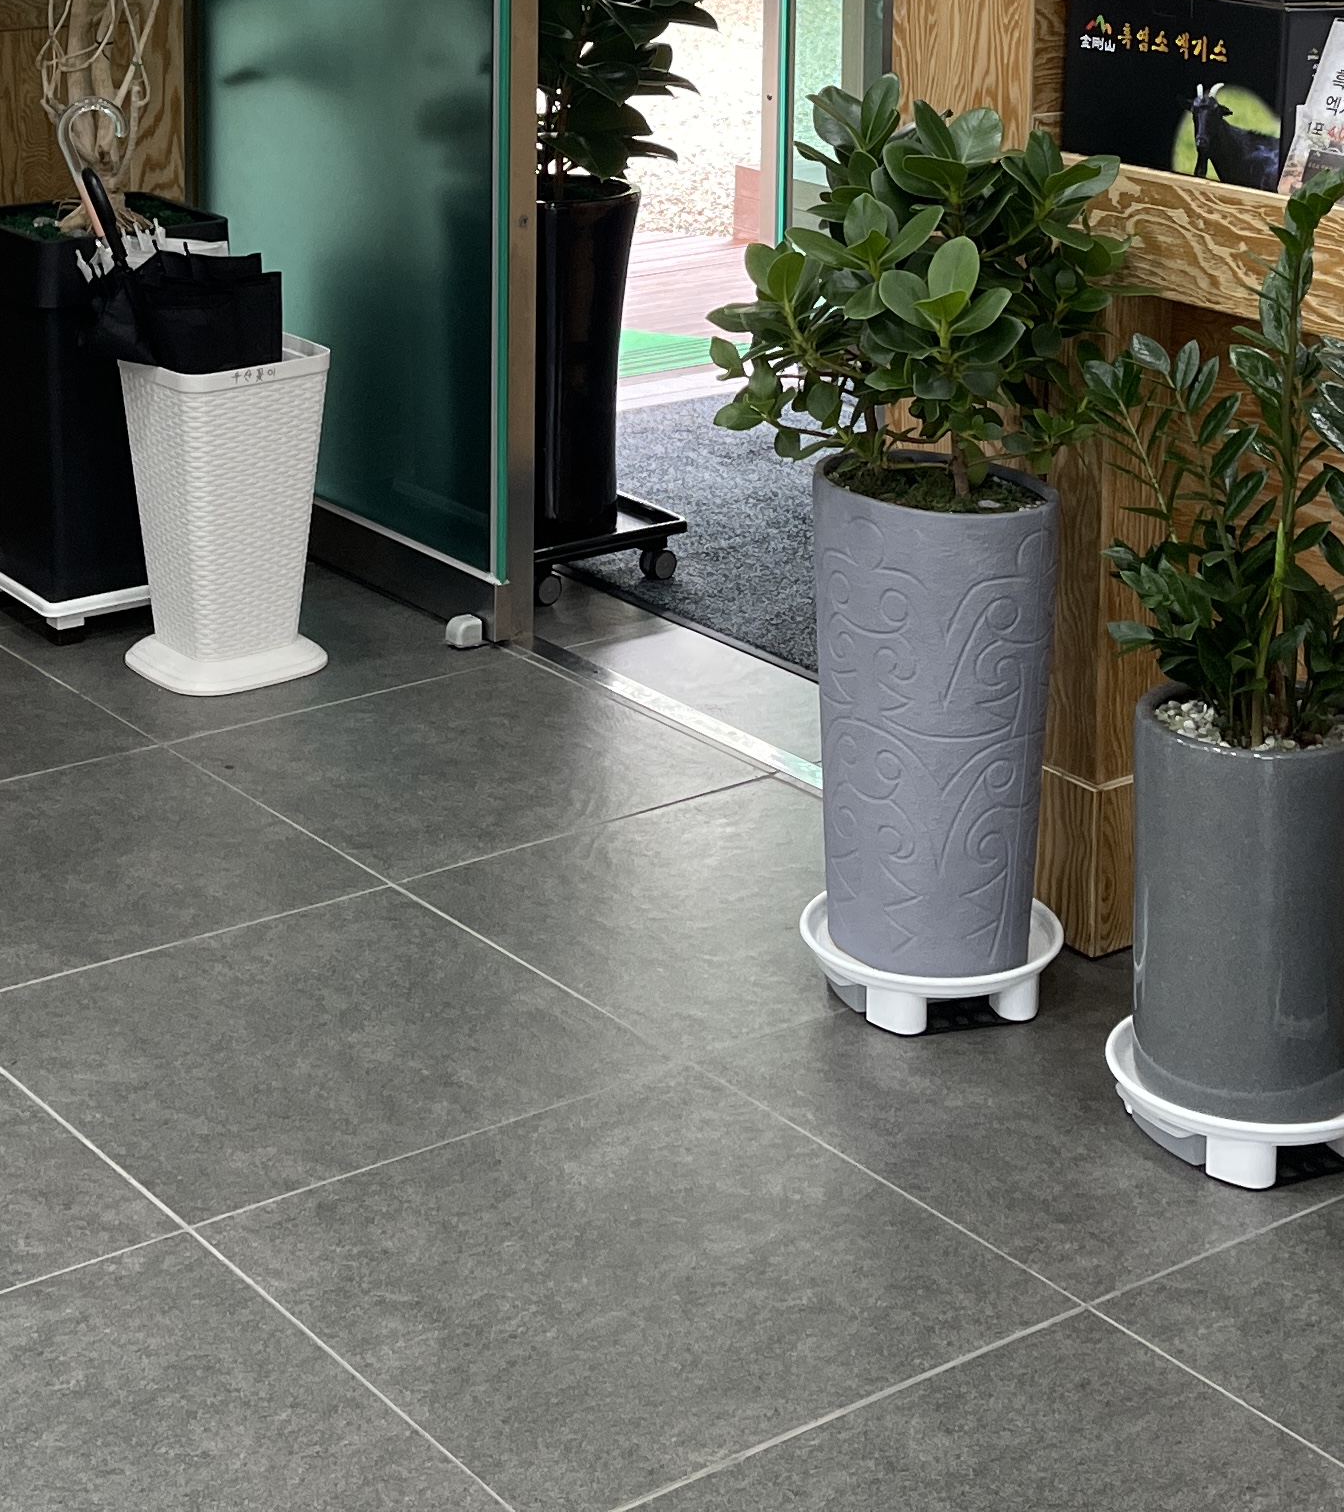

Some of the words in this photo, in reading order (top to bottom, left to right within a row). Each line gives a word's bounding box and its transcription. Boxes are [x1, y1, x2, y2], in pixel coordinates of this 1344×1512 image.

[1079, 33, 1116, 53] 金剛山
[1117, 21, 1170, 53] 흑염소
[1175, 31, 1228, 63] 엑기스
[1307, 120, 1325, 137] 1포
